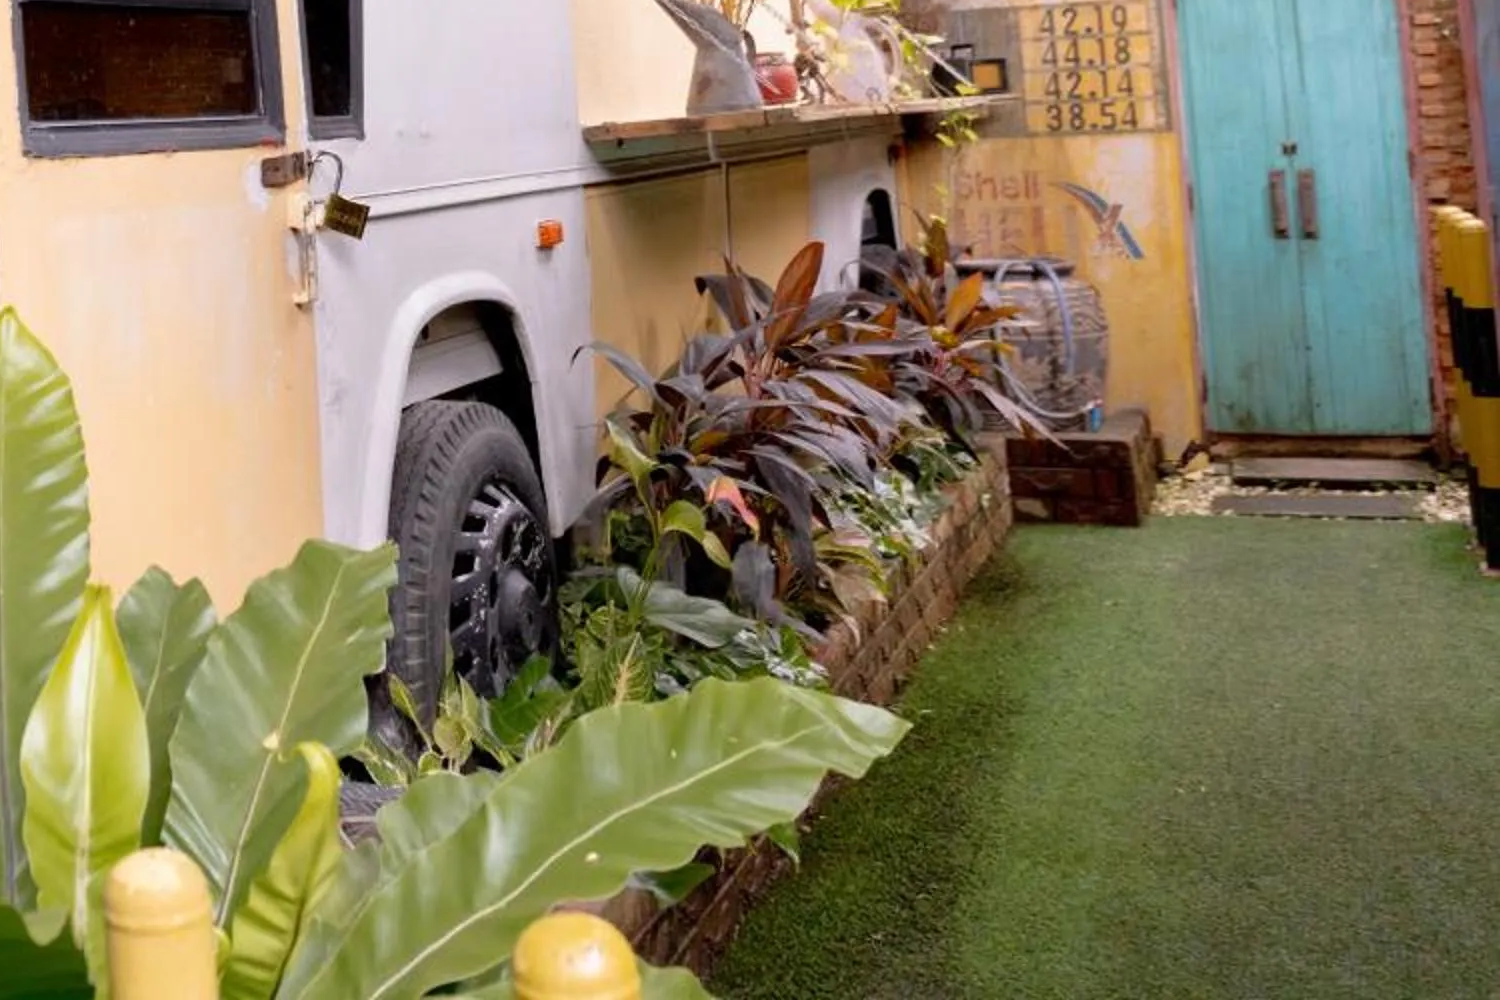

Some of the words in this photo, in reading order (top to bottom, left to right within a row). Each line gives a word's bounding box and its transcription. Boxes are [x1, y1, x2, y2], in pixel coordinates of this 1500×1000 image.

[1038, 4, 1128, 38] 42.19
[1041, 36, 1131, 70] 44.18
[1044, 69, 1135, 101] 42.14
[1046, 101, 1138, 132] 38.54
[955, 170, 1040, 201] Shell
